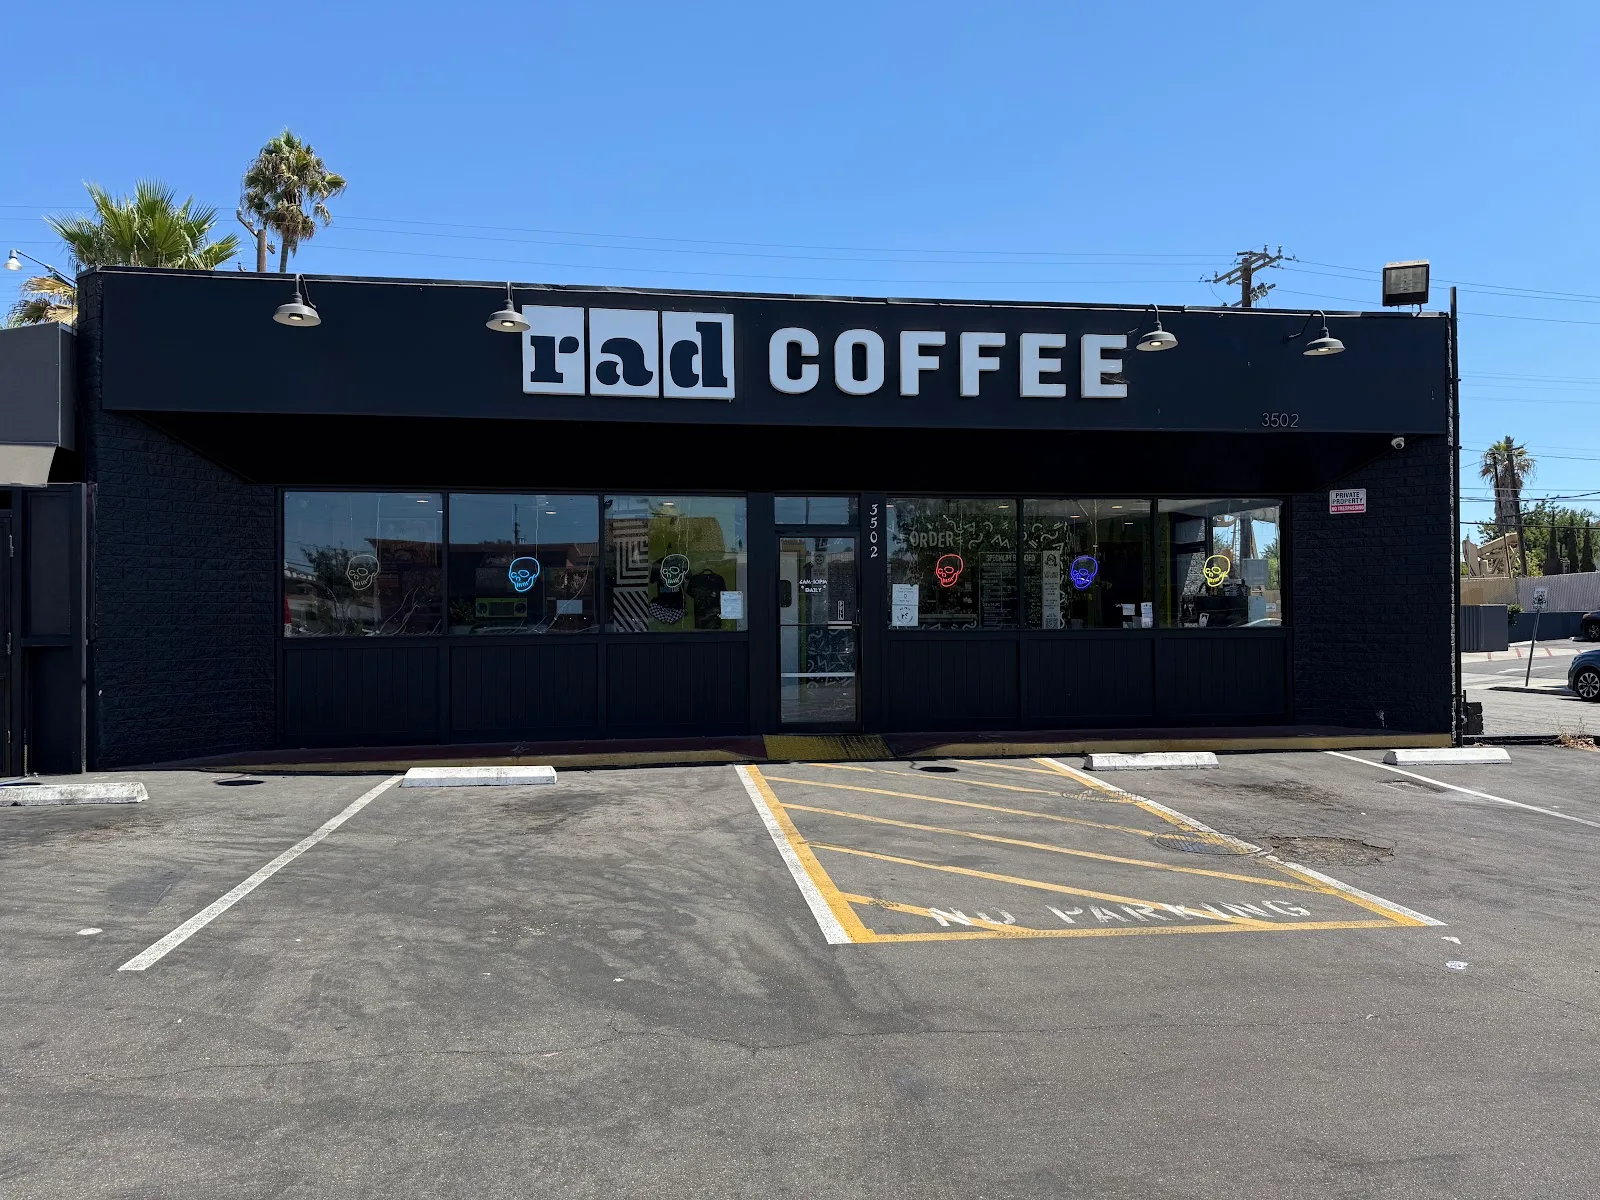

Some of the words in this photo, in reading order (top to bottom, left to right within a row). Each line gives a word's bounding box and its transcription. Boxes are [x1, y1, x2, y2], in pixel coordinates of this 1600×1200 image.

[528, 321, 729, 389] rad
[767, 327, 1129, 399] COFFEE
[1260, 412, 1299, 428] 3502
[869, 503, 879, 558] 3502
[909, 530, 955, 548] ORDER
[1044, 899, 1312, 924] PARKING
